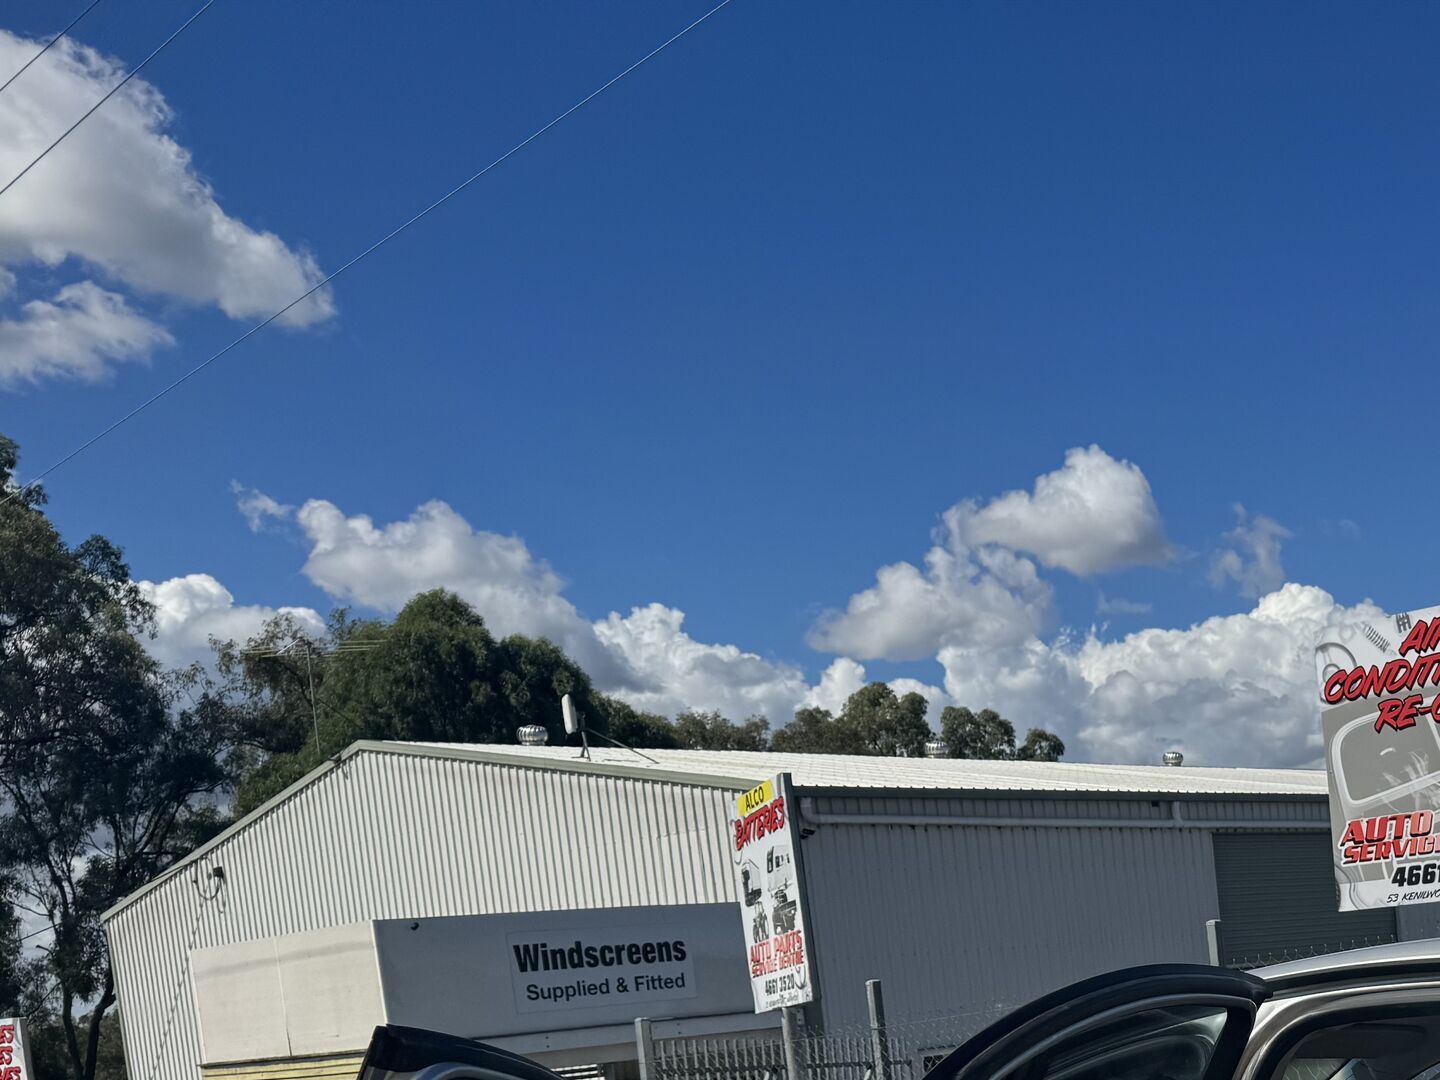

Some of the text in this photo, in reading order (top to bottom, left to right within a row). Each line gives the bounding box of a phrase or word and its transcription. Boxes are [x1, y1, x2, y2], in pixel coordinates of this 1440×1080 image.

[745, 786, 765, 811] ALCO
[735, 795, 785, 851] BATTERIES
[1341, 810, 1433, 847] AUTO
[1387, 893, 1399, 903] 53
[512, 940, 687, 973] Windscreens
[750, 930, 803, 965] AUTO PARTS
[526, 973, 685, 1003] Supplied & Fitted
[765, 973, 795, 996] 4661 3520
